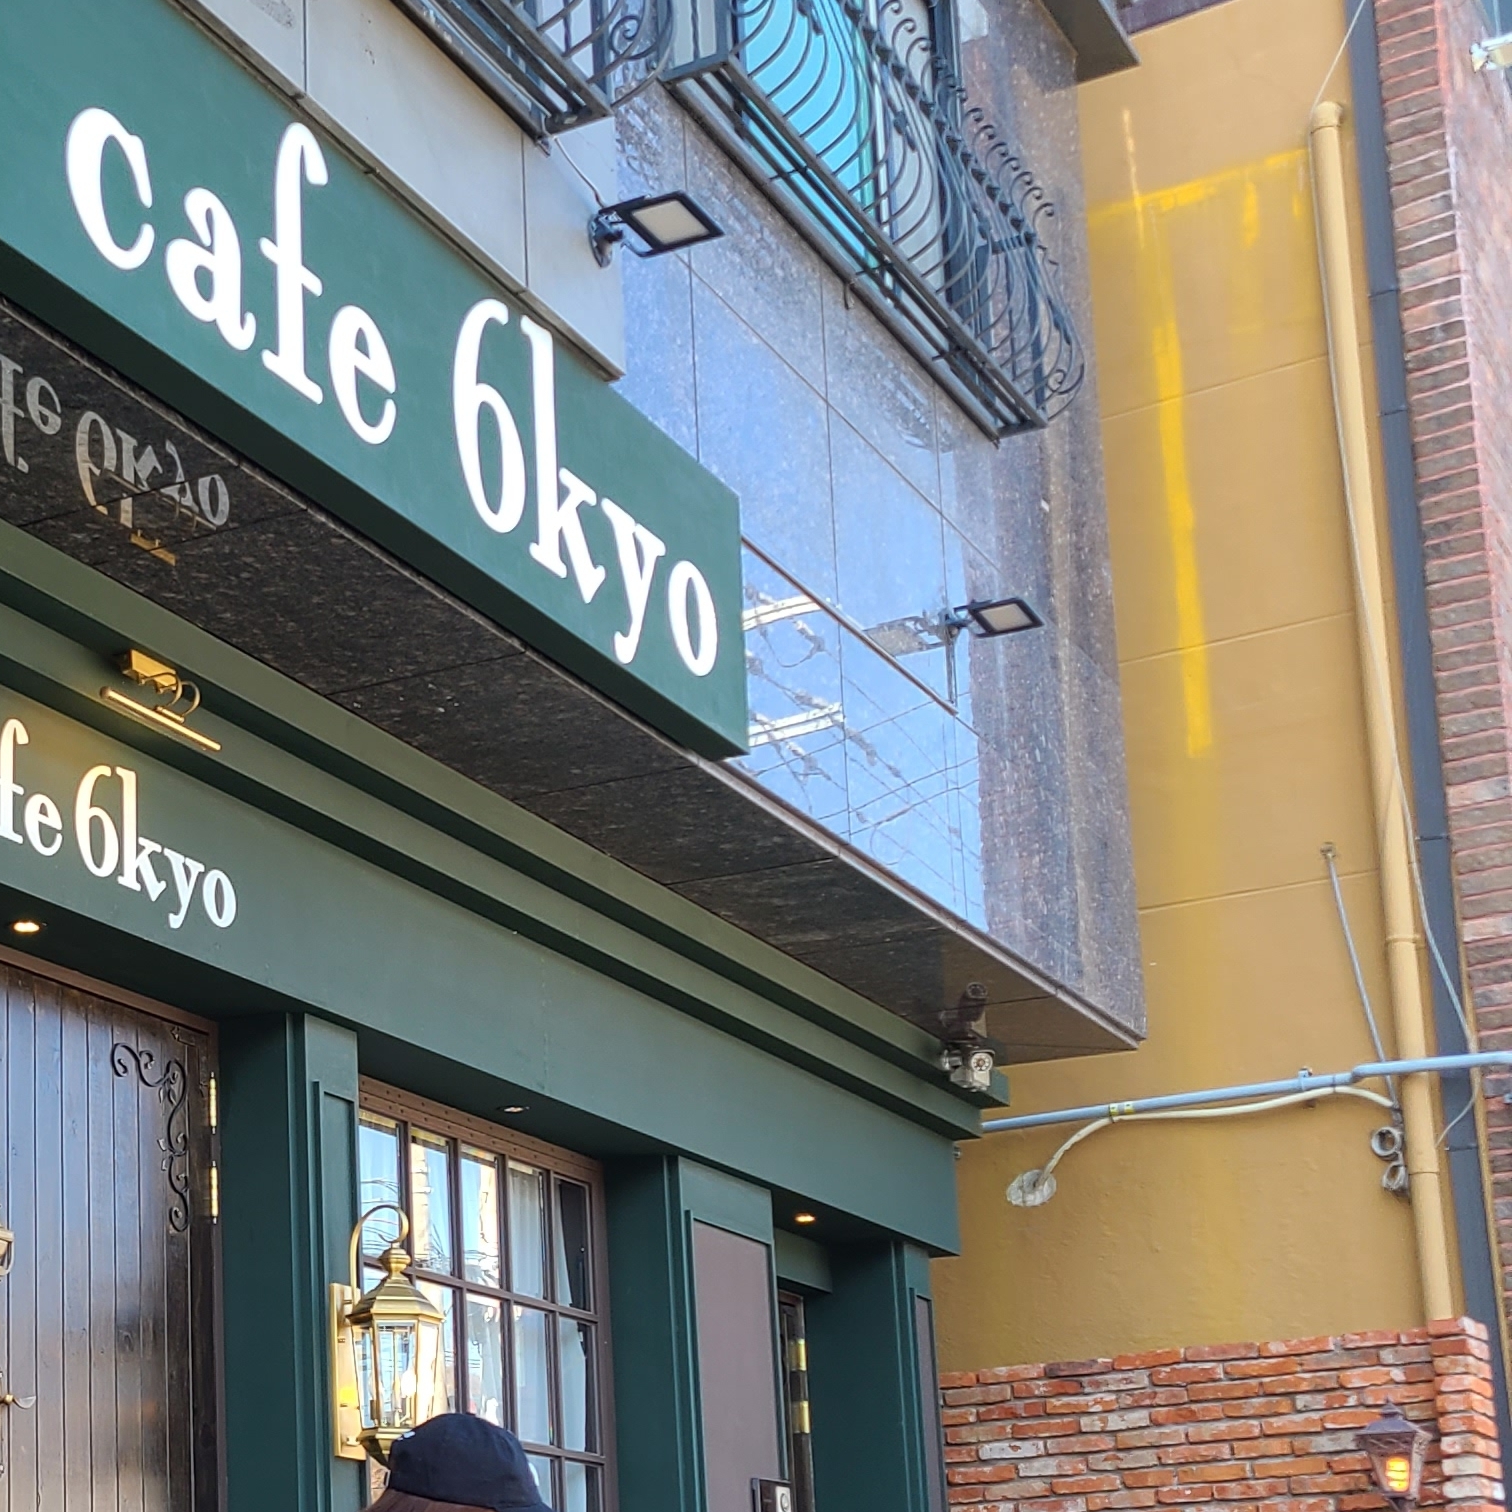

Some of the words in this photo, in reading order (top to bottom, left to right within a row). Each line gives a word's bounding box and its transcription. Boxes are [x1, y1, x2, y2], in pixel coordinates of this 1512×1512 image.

[65, 107, 397, 445] cafe
[452, 298, 719, 678] 6kyo
[74, 765, 238, 929] 6kyo
